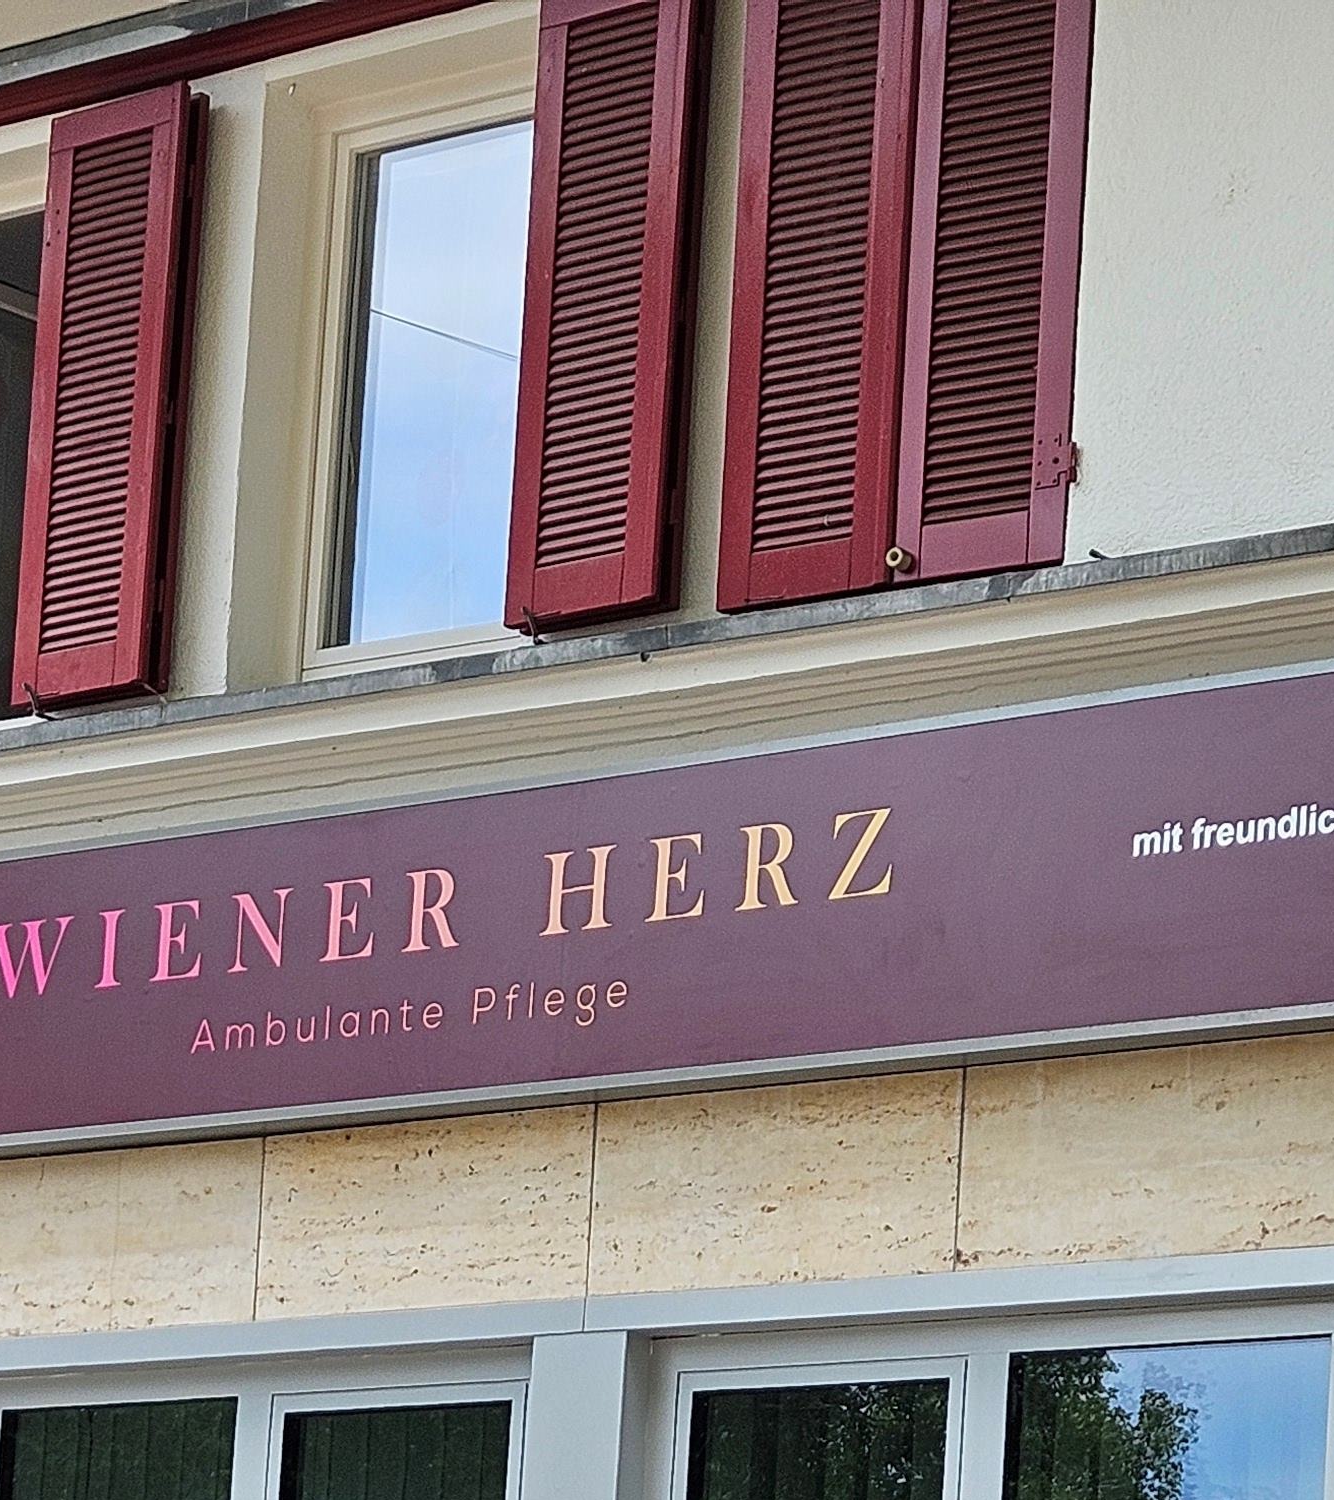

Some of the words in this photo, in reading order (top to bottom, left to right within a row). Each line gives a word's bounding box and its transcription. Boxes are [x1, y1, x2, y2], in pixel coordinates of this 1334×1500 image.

[541, 807, 895, 938] HERZ
[1132, 820, 1183, 858] mit
[189, 996, 445, 1055] Ambulante
[471, 977, 630, 1031] Pflege
